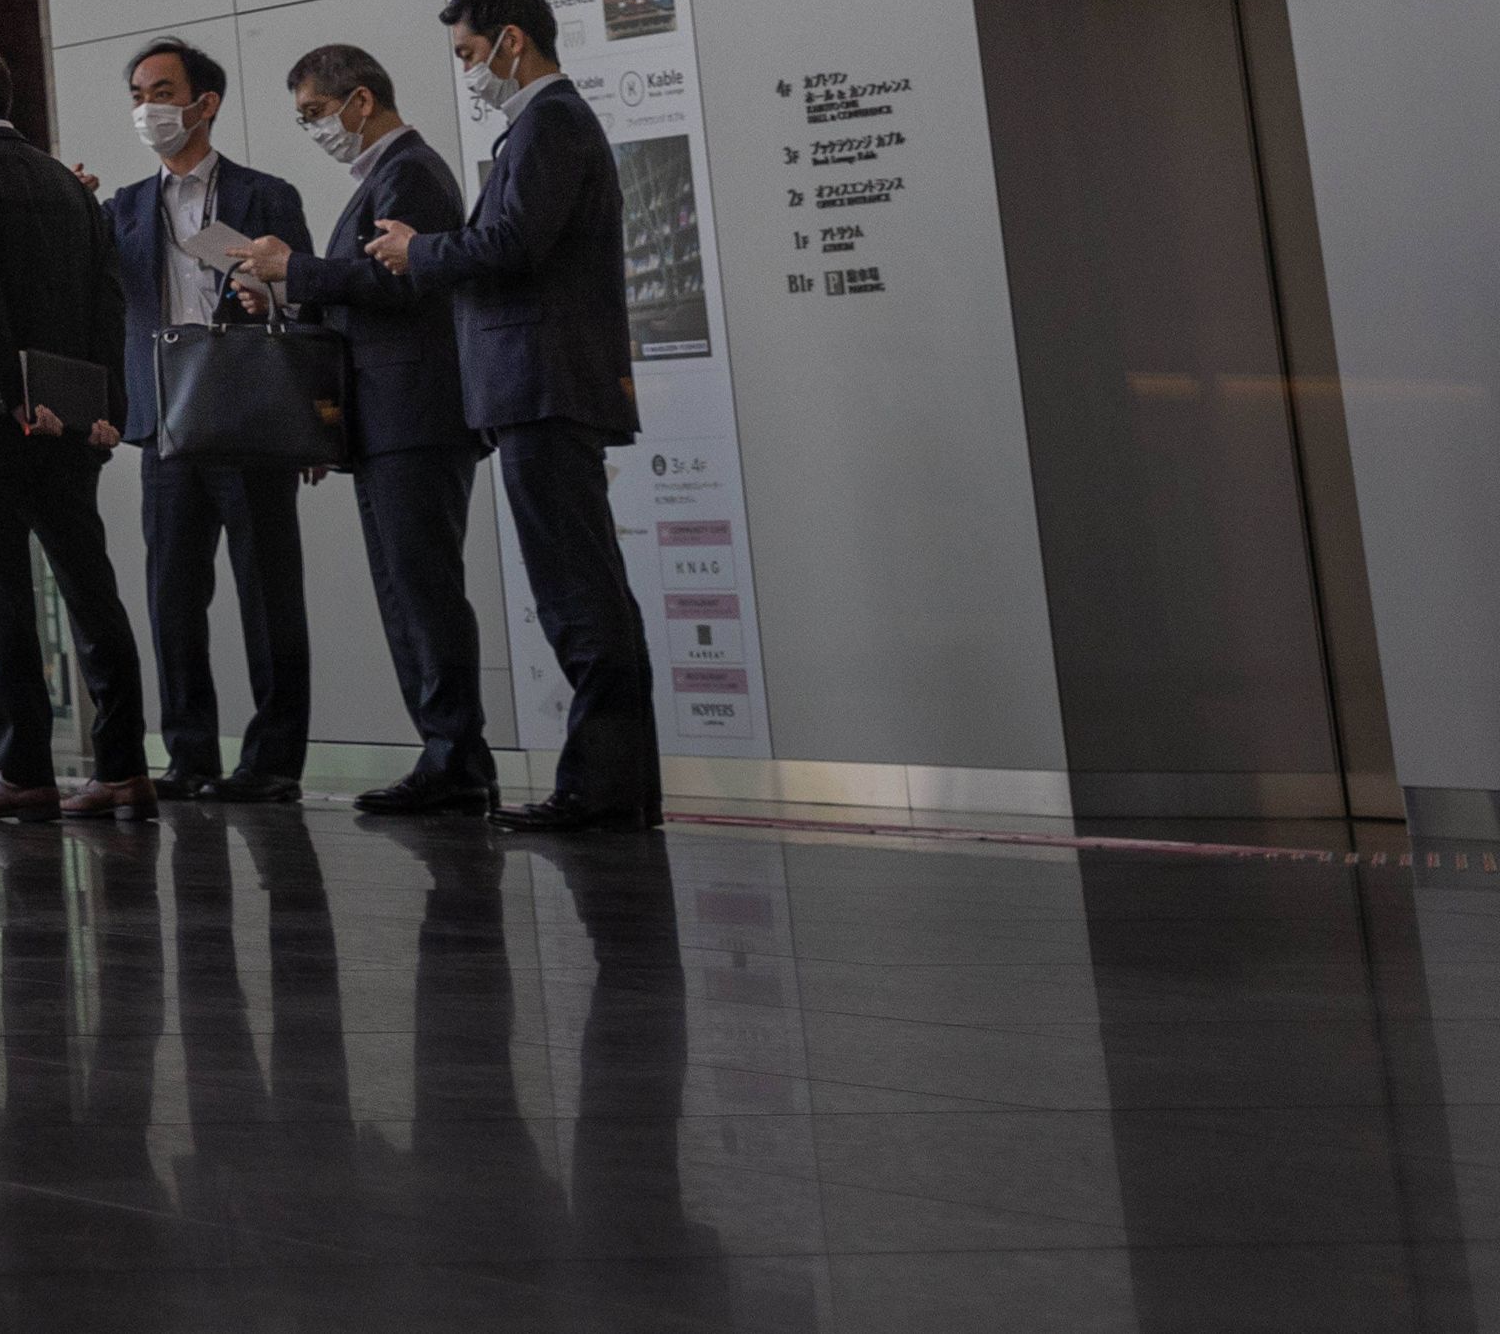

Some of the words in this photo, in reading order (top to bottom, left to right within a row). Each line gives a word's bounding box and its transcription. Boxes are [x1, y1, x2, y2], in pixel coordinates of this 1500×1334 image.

[647, 71, 684, 89] Kable
[783, 146, 800, 165] 3F
[787, 189, 804, 207] 2F
[793, 231, 810, 250] 1F
[787, 274, 814, 294] B1F
[675, 560, 721, 575] KNAG
